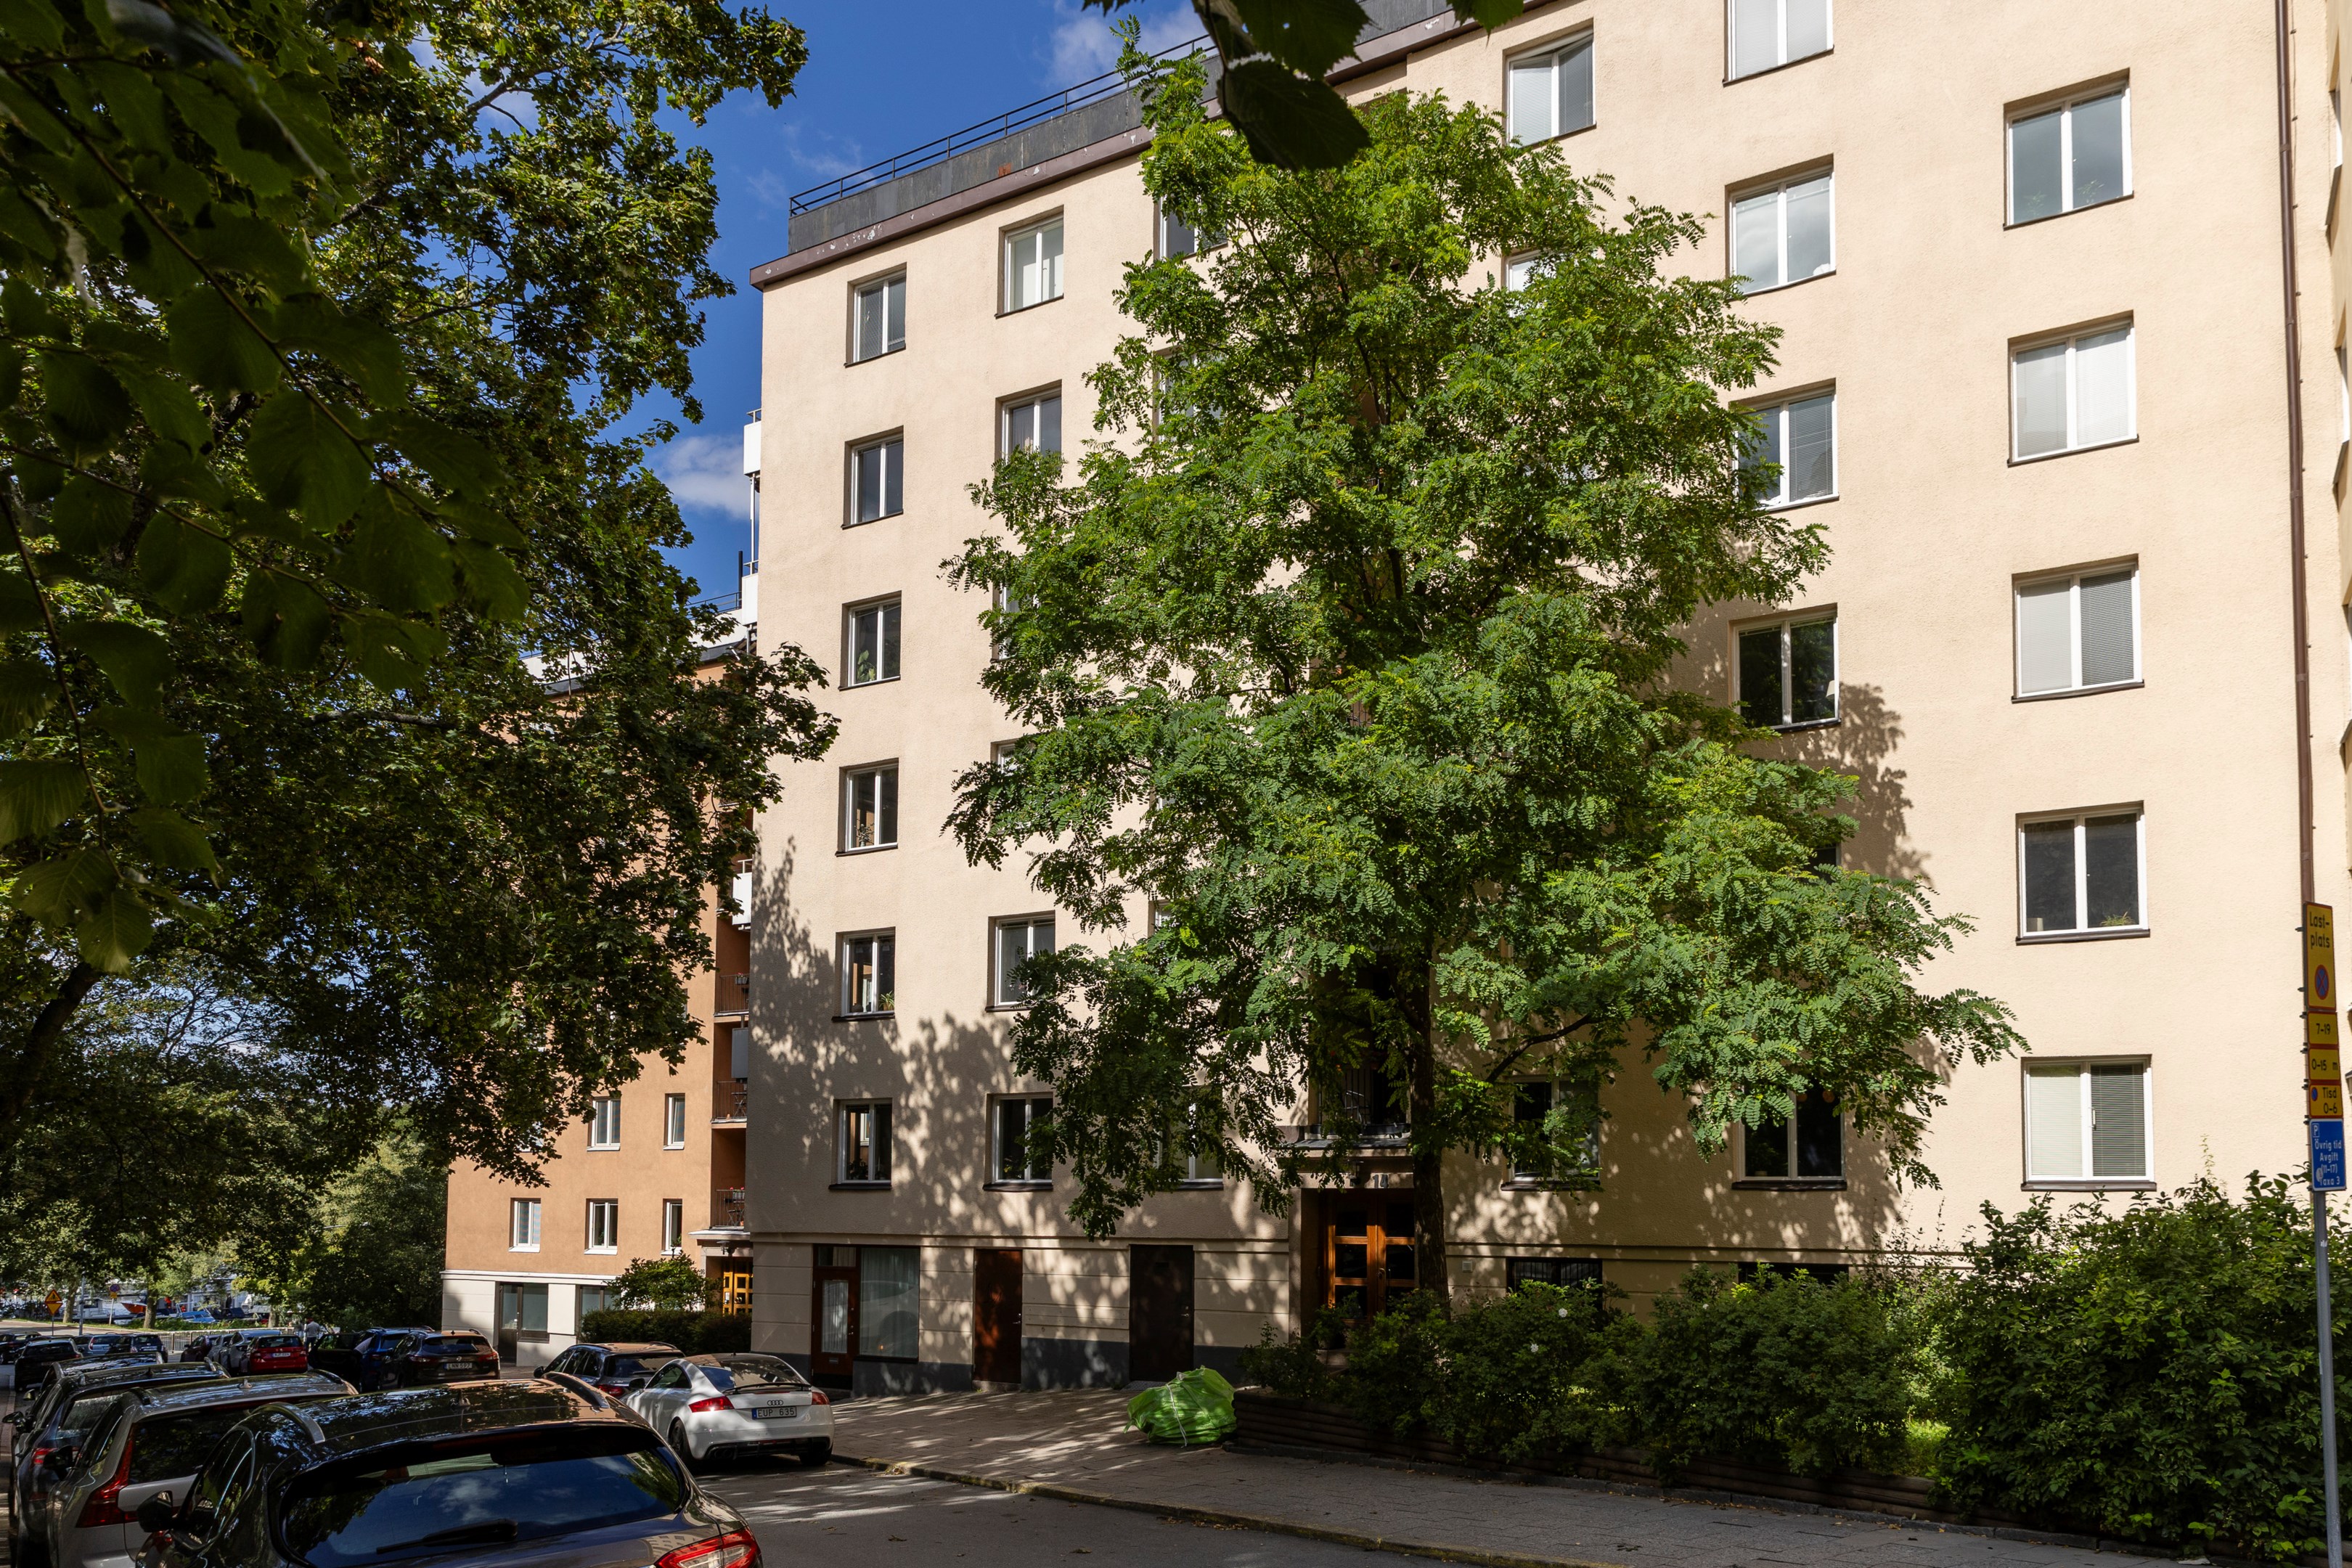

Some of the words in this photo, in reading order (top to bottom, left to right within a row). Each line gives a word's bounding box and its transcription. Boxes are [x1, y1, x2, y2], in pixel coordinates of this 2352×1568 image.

[2310, 911, 2329, 928] Last-
[2311, 931, 2329, 950] plats
[2316, 1023, 2330, 1034] 7-19
[2311, 1058, 2327, 1071] 0-15
[2332, 1061, 2338, 1071] m
[2323, 1087, 2337, 1098] Tisd
[2324, 1102, 2337, 1114] 0-6
[2314, 1138, 2332, 1151] Övrig
[2333, 1140, 2342, 1149] tid
[2319, 1152, 2339, 1164] Avgift
[2321, 1164, 2337, 1174] (11-17)
[1372, 1174, 1389, 1189] 14
[2336, 1176, 2340, 1185] 3
[779, 1408, 795, 1416] 635
